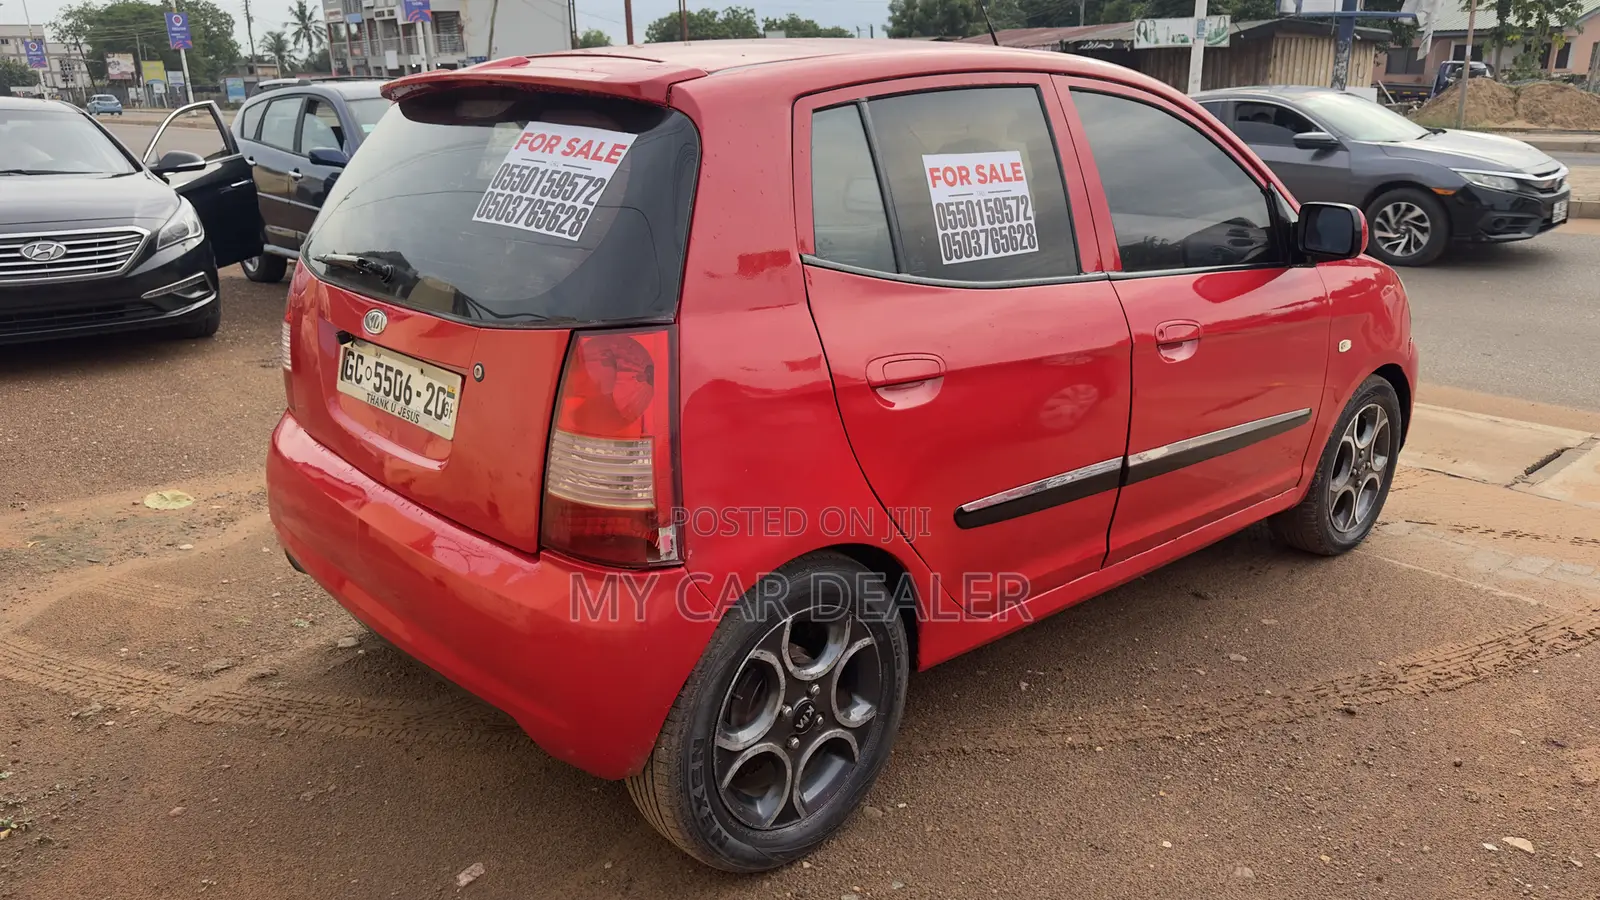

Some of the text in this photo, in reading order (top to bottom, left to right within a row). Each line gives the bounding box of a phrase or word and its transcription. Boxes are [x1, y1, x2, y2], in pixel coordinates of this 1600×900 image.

[514, 132, 628, 165] FOR SALE
[491, 163, 606, 206] 0550159572
[928, 162, 1024, 188] FOR SALE
[476, 191, 590, 237] 0503765628
[935, 195, 1032, 231] 0550159572
[941, 223, 1037, 261] 0503765628
[344, 351, 364, 385] GC
[366, 393, 420, 424] THANK U JESUS
[795, 705, 815, 729] KIA
